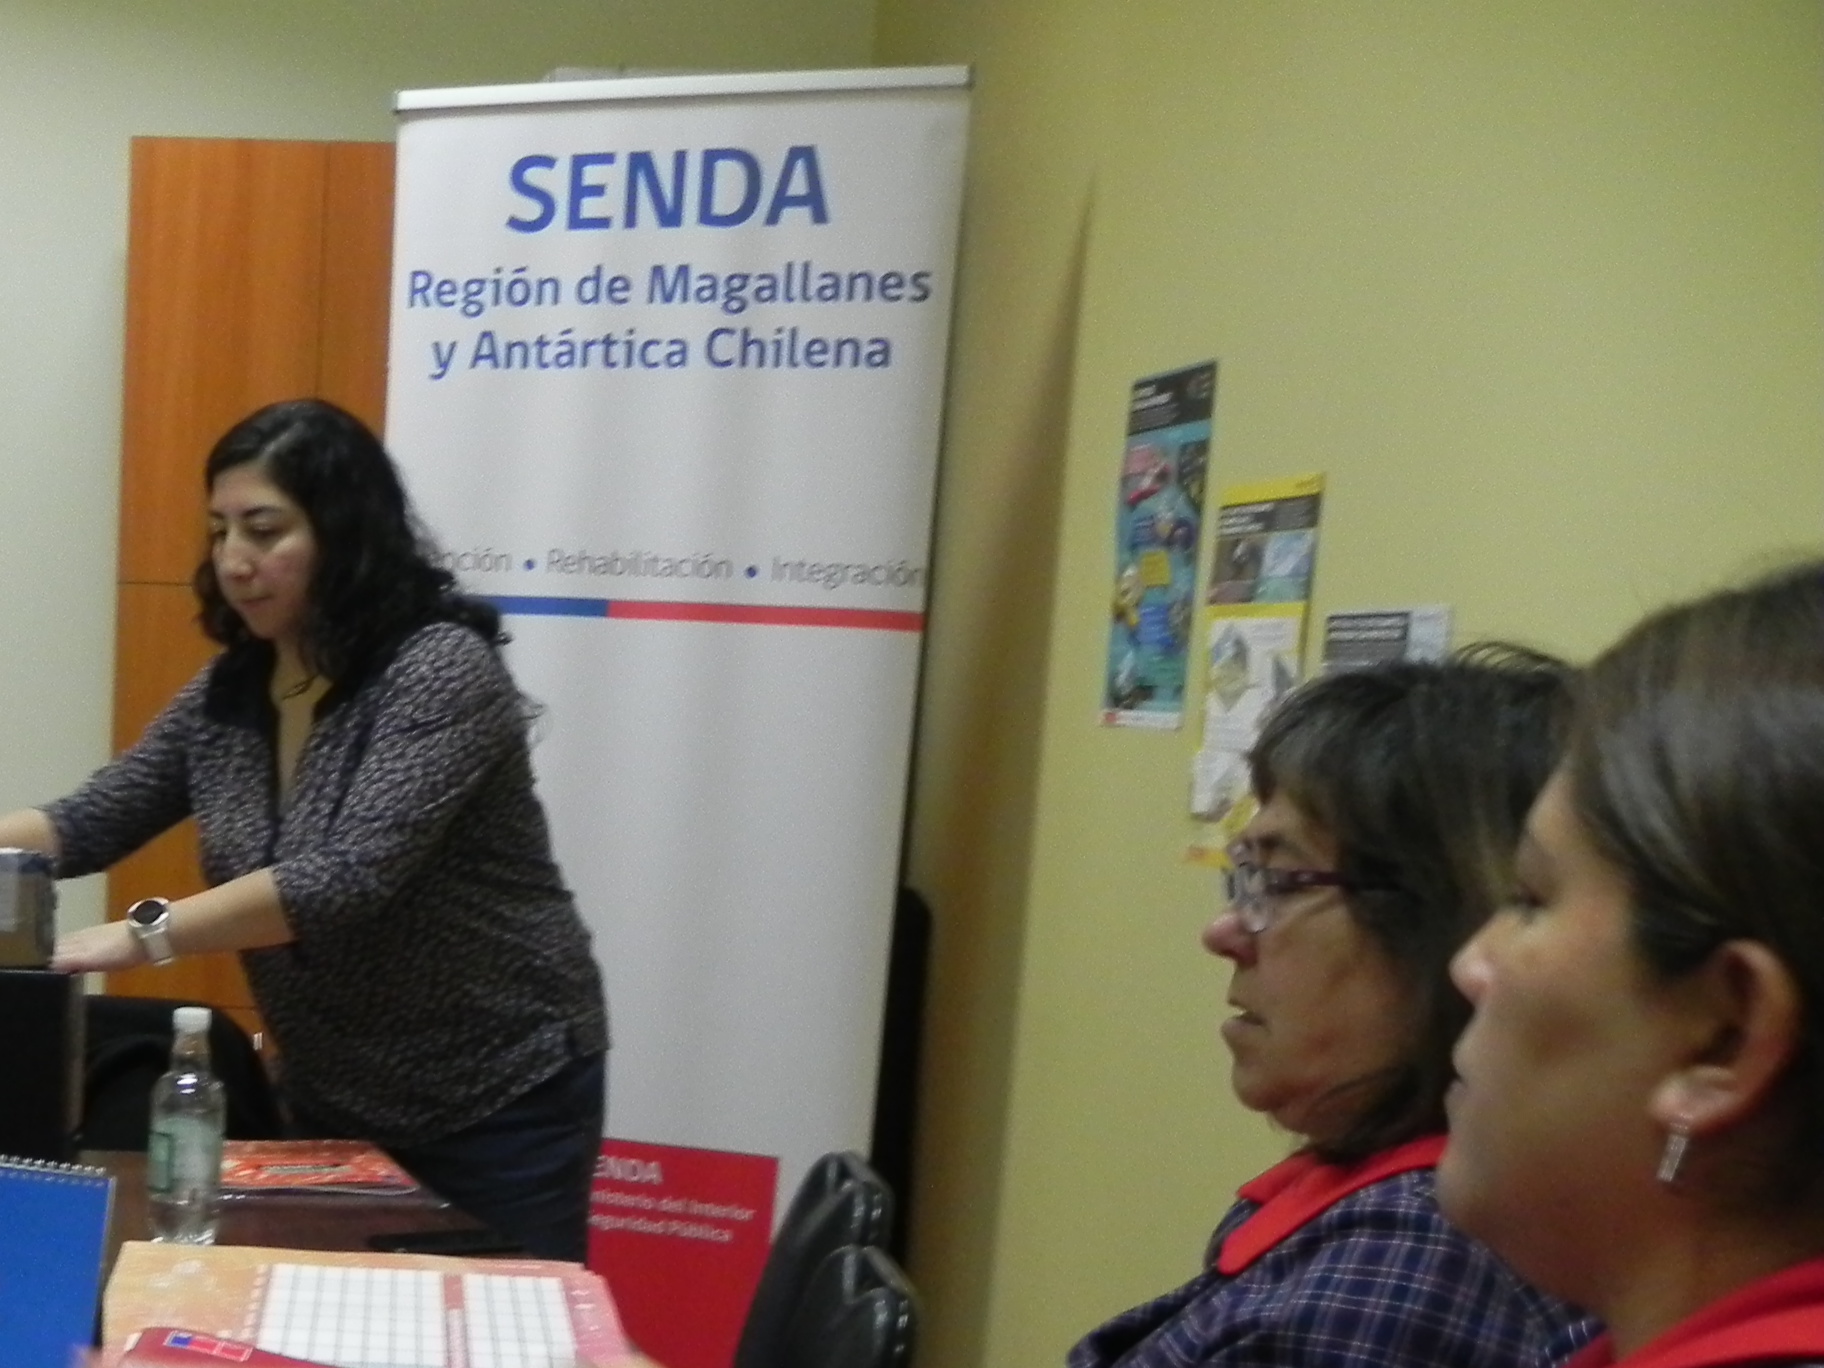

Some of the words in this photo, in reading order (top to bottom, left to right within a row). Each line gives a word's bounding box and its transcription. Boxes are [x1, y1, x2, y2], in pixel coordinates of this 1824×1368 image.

[505, 144, 831, 233] SENDA
[406, 266, 562, 319] Región
[575, 265, 632, 306] de
[645, 260, 934, 316] Magallanes
[427, 336, 459, 381] y
[468, 328, 689, 371] Antártica
[704, 326, 893, 370] Chilena
[545, 547, 734, 582] Rehabilitación
[771, 556, 925, 590] Integración
[592, 1154, 664, 1186] ENDA
